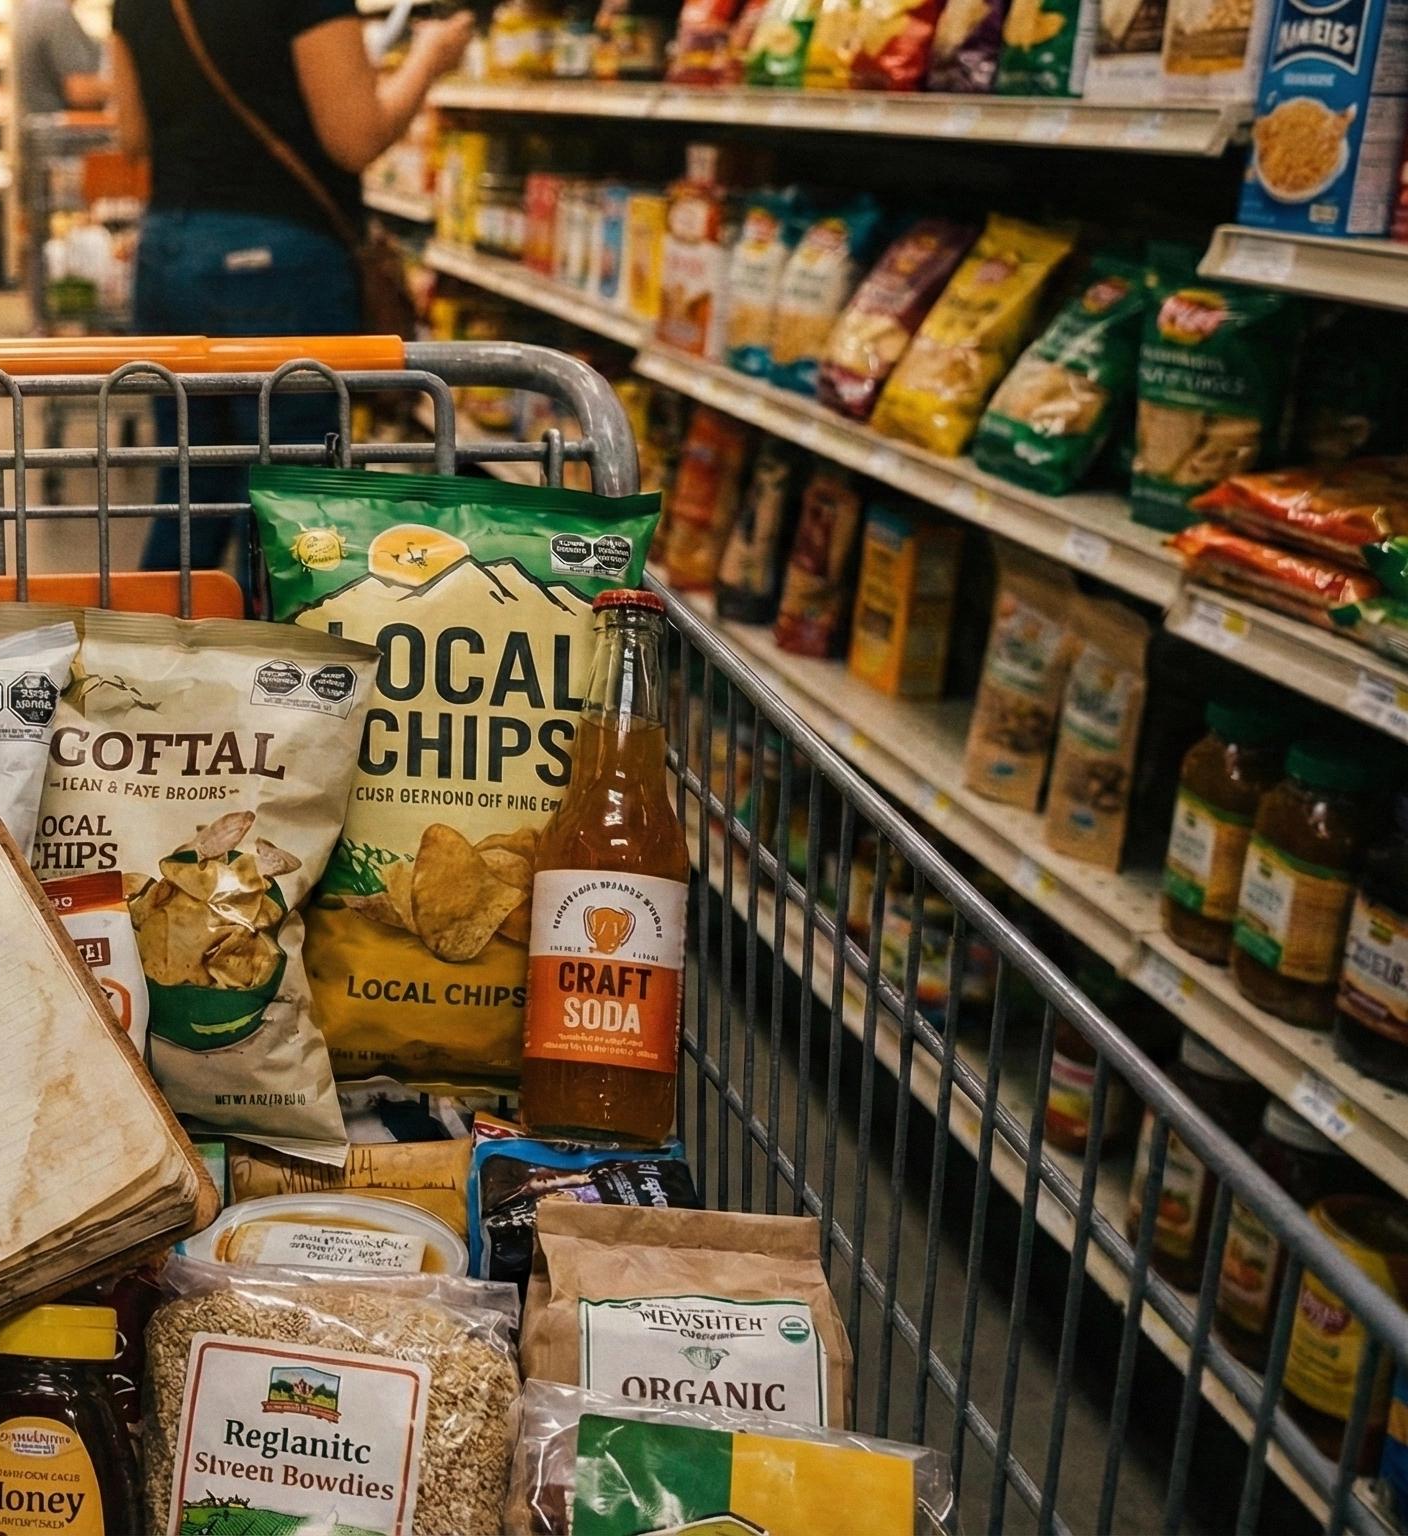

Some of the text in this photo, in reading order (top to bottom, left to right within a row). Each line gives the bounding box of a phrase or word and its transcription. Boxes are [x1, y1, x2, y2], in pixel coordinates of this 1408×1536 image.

[328, 621, 585, 711] OCAL
[51, 727, 285, 780] GOFTAL
[357, 708, 575, 787] CHIPS
[107, 781, 117, 793] &
[124, 783, 160, 798] FAYE
[478, 793, 503, 807] OFF
[35, 815, 112, 837] OCAL
[347, 975, 528, 1008] LOCAL CHIPS
[558, 961, 652, 1000] CRAFT
[563, 996, 640, 1034] SODA
[622, 1376, 786, 1411] ORGANIC
[223, 1418, 371, 1465] Reglanitc
[281, 1464, 395, 1501] Bowdies
